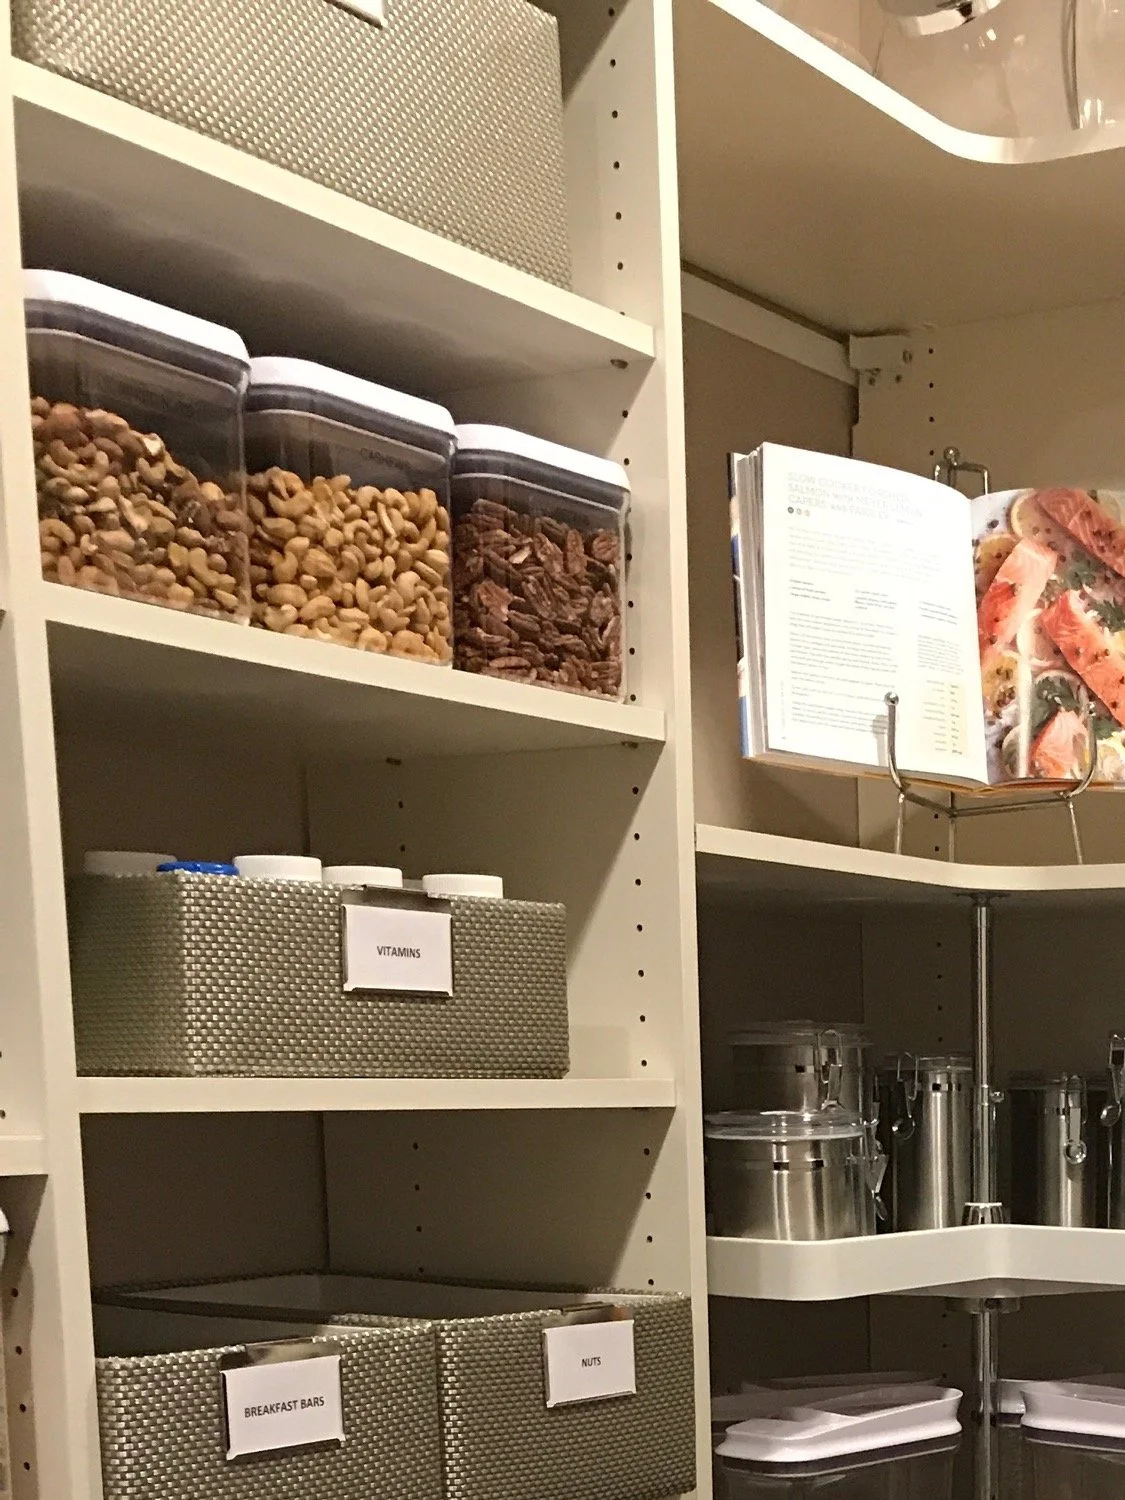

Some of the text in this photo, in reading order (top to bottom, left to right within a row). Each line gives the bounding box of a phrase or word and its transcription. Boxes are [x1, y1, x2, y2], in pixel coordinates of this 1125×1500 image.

[376, 945, 421, 959] VITAMINS
[581, 1356, 602, 1367] NUTS
[244, 1396, 325, 1418] BREAKFAST BARS
